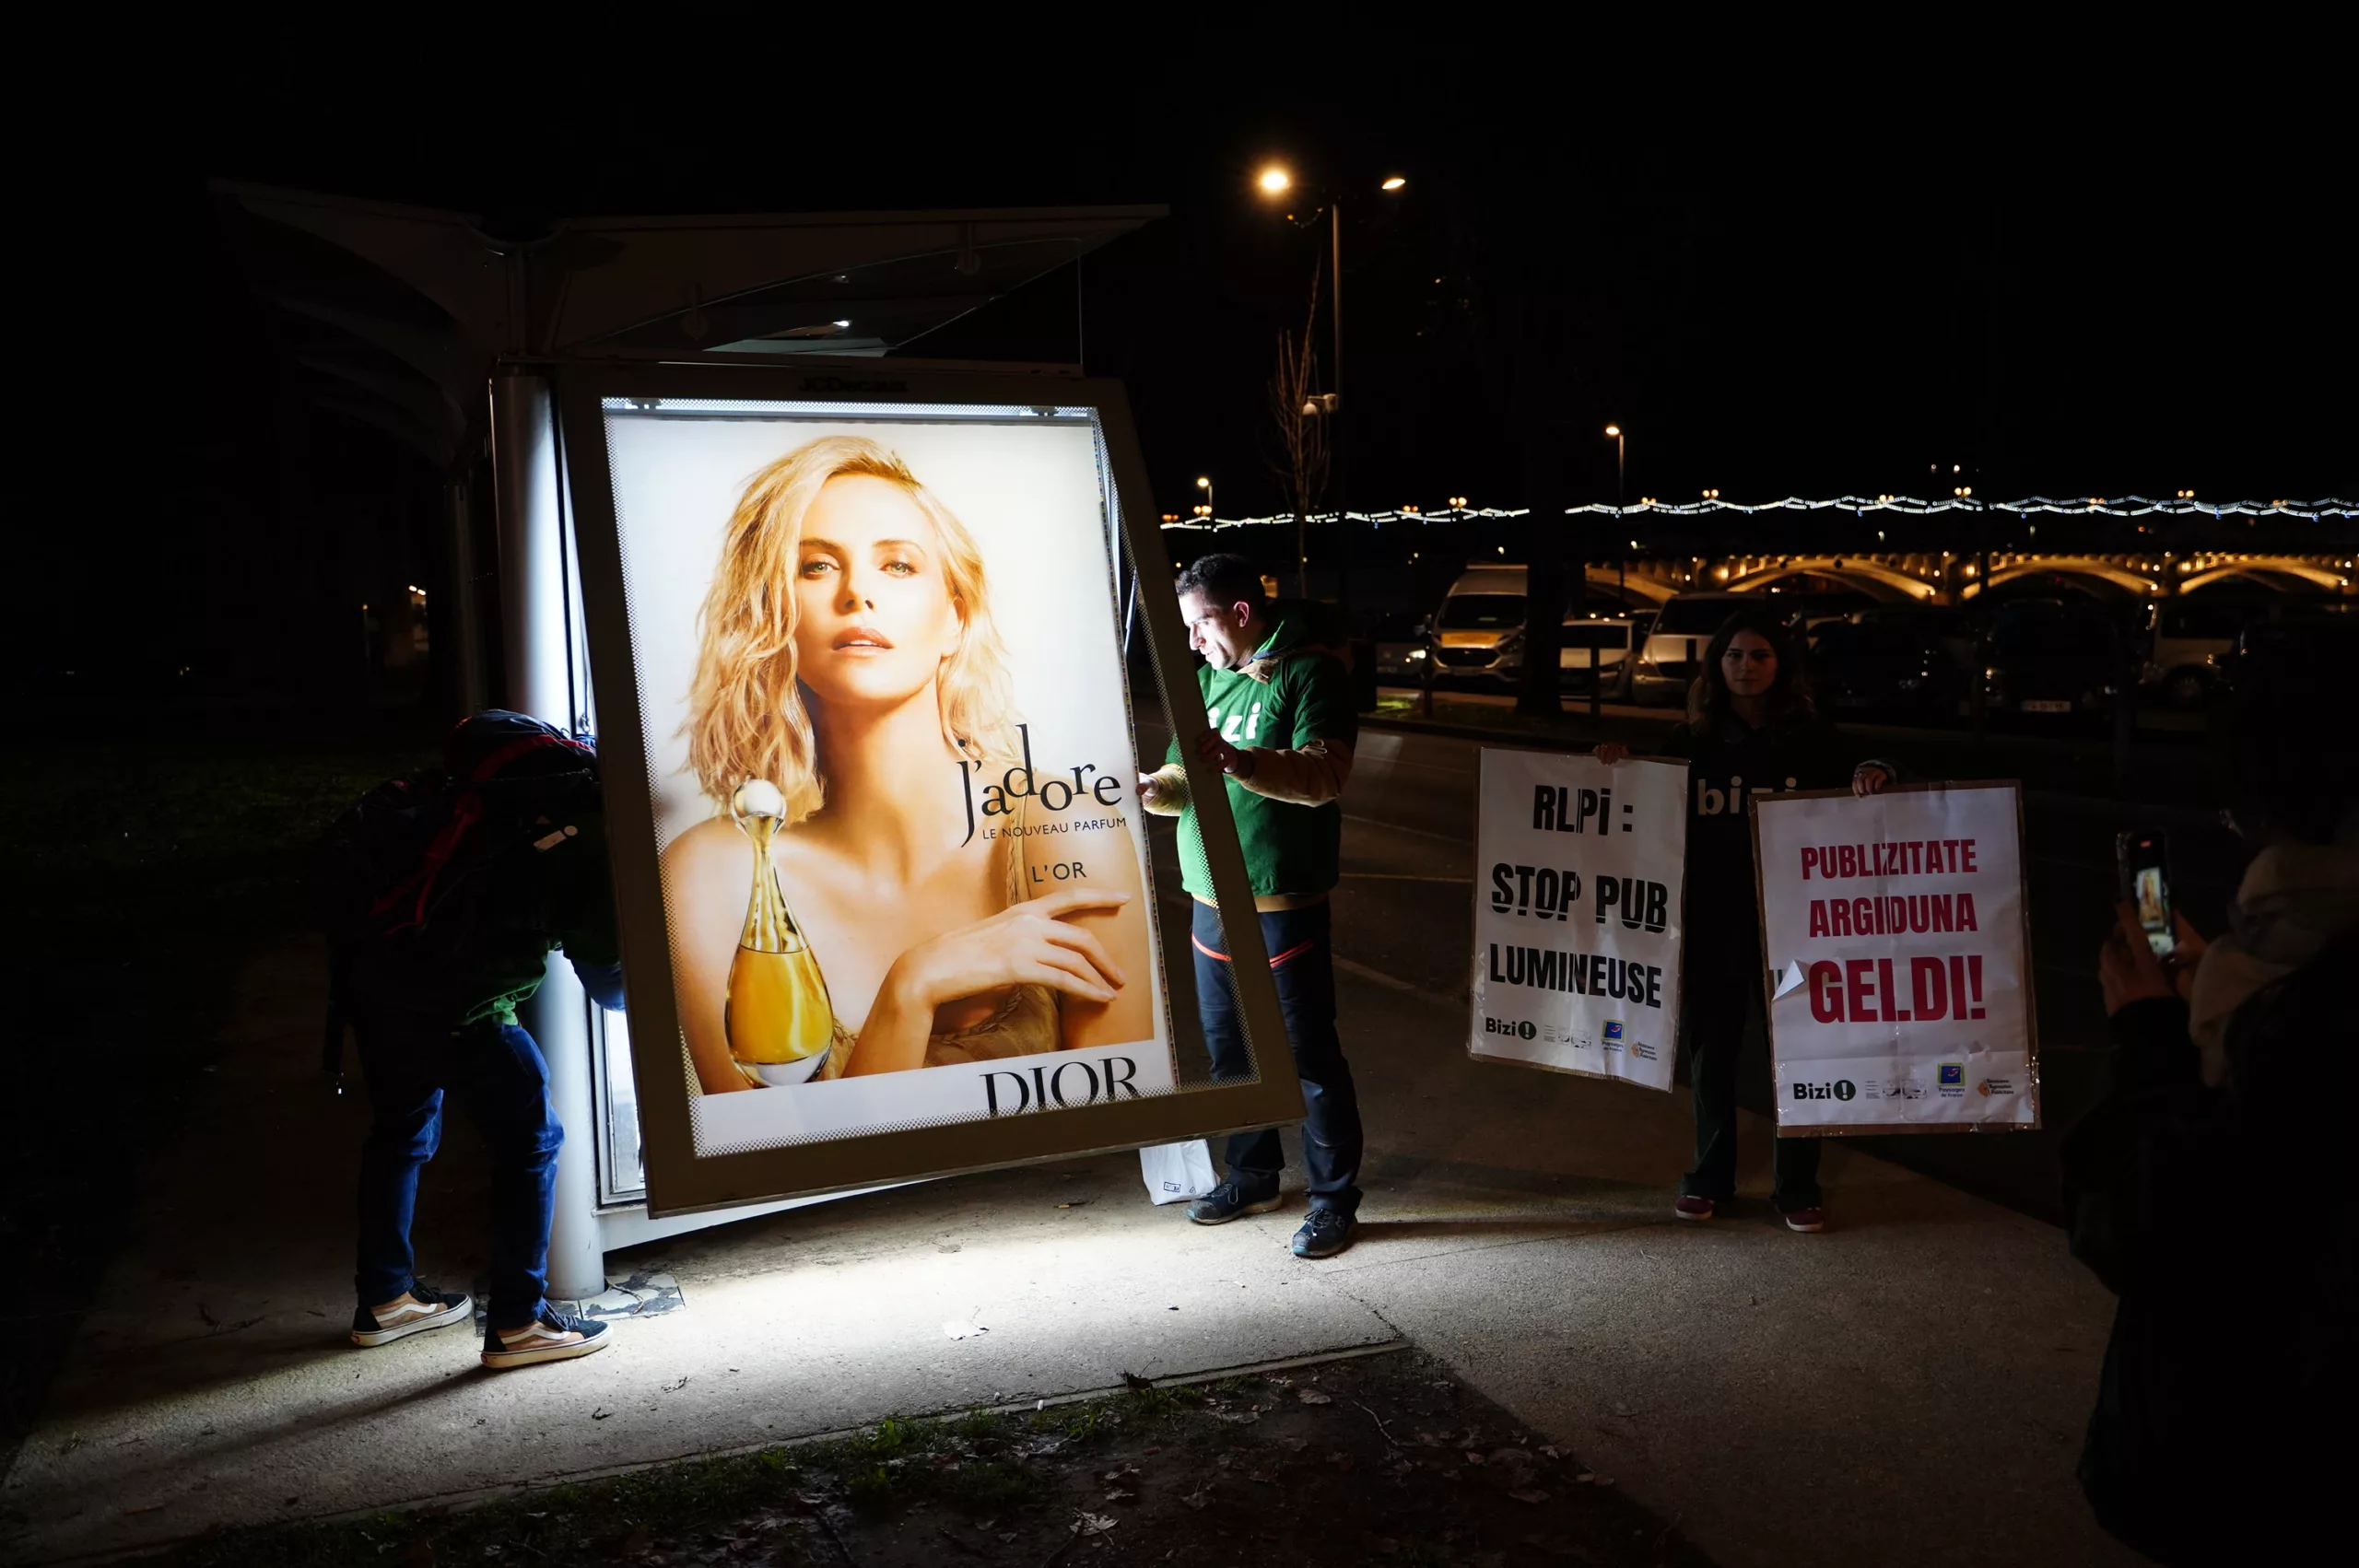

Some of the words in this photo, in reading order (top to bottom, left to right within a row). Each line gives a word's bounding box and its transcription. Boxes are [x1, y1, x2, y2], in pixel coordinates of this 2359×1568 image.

[956, 723, 1122, 848] j'adore
[982, 828, 997, 840] LE
[1002, 822, 1069, 838] NOUVEAU
[1074, 817, 1126, 832] PARFUM
[1031, 861, 1086, 883] L'OR
[1801, 839, 1978, 880] PUBLIZITATE
[1492, 862, 1581, 921] STOP
[1595, 875, 1668, 934] PUB
[1809, 893, 1978, 938] ARGIDUNA
[1489, 943, 1661, 1009] LUMINEUSE
[1808, 954, 1987, 1024] GELDI!
[980, 1057, 1142, 1118] DIOR
